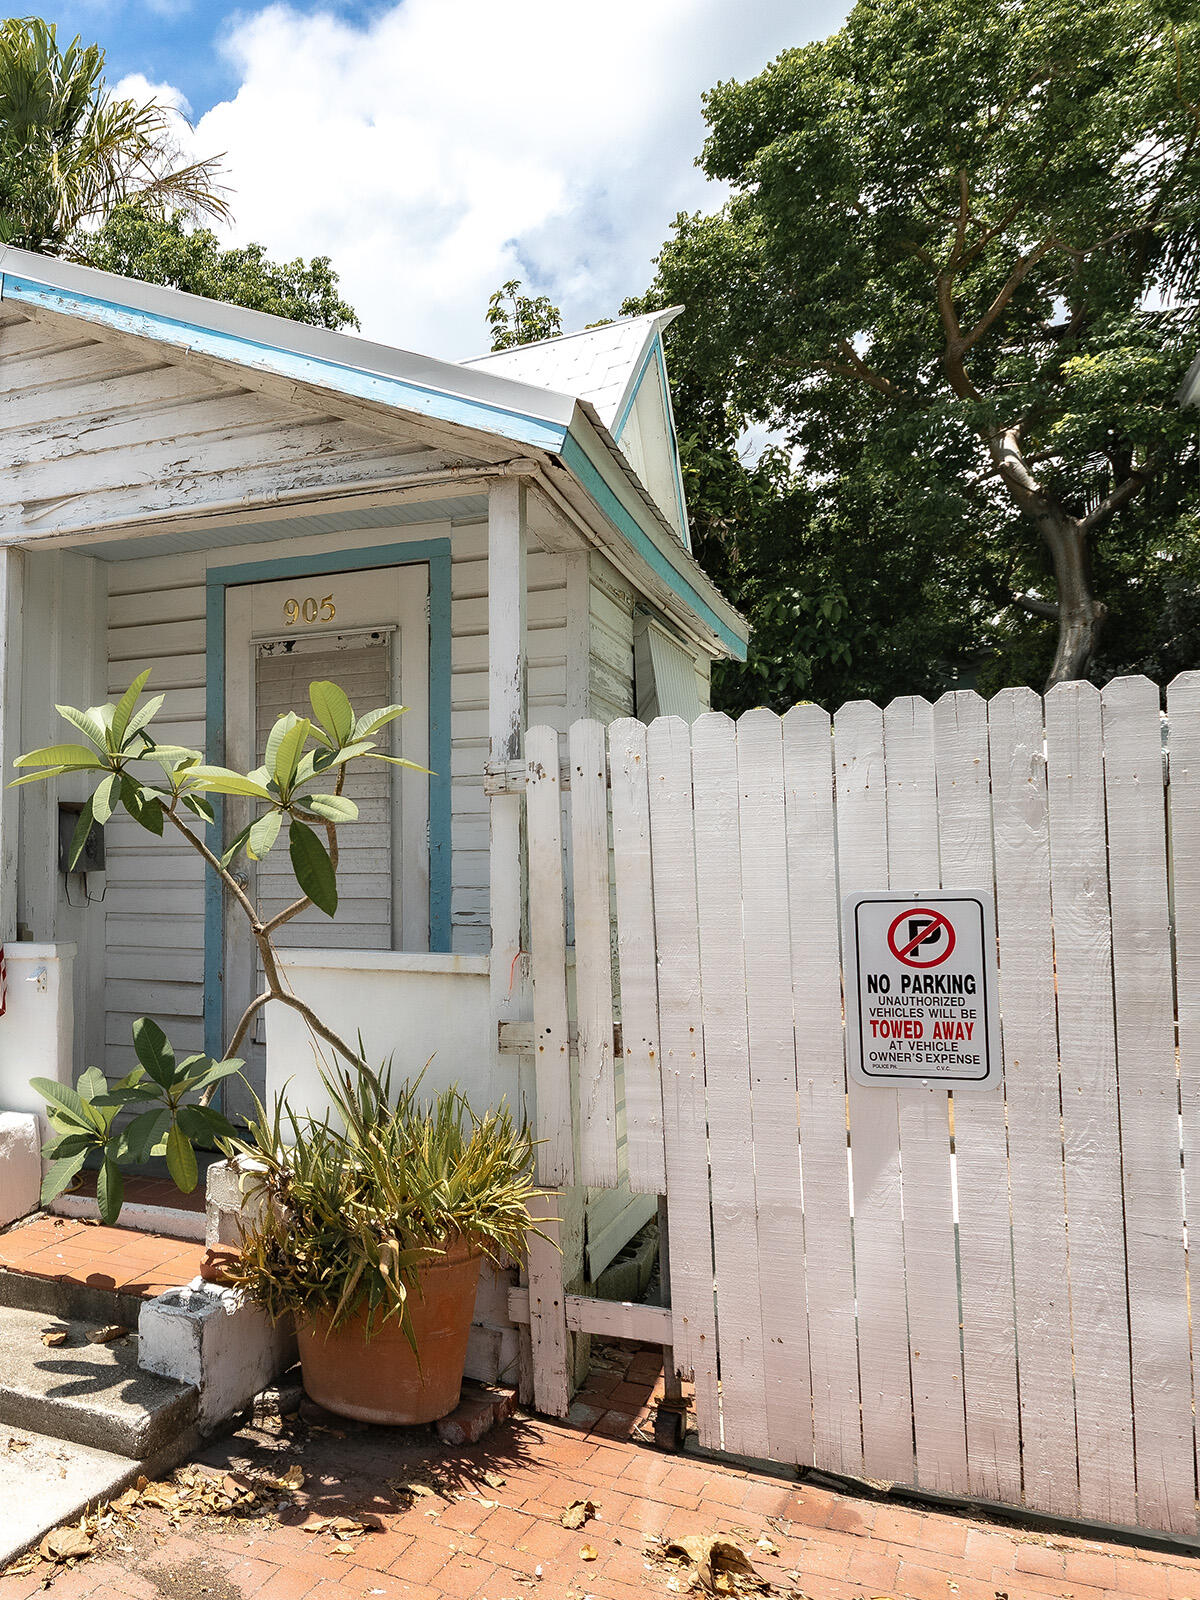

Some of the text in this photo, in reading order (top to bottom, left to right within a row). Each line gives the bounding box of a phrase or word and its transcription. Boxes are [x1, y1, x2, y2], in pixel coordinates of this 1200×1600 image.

[283, 593, 336, 626] 905
[867, 974, 977, 995] NO PARKING
[879, 996, 965, 1007] UNAUTHORIZED
[869, 1007, 977, 1019] VEHICLES WILL BE
[869, 1020, 975, 1041] TOWED AWAY
[889, 1041, 959, 1052] AT VEHICLE
[869, 1051, 980, 1065] OWNER'S EXPENSE
